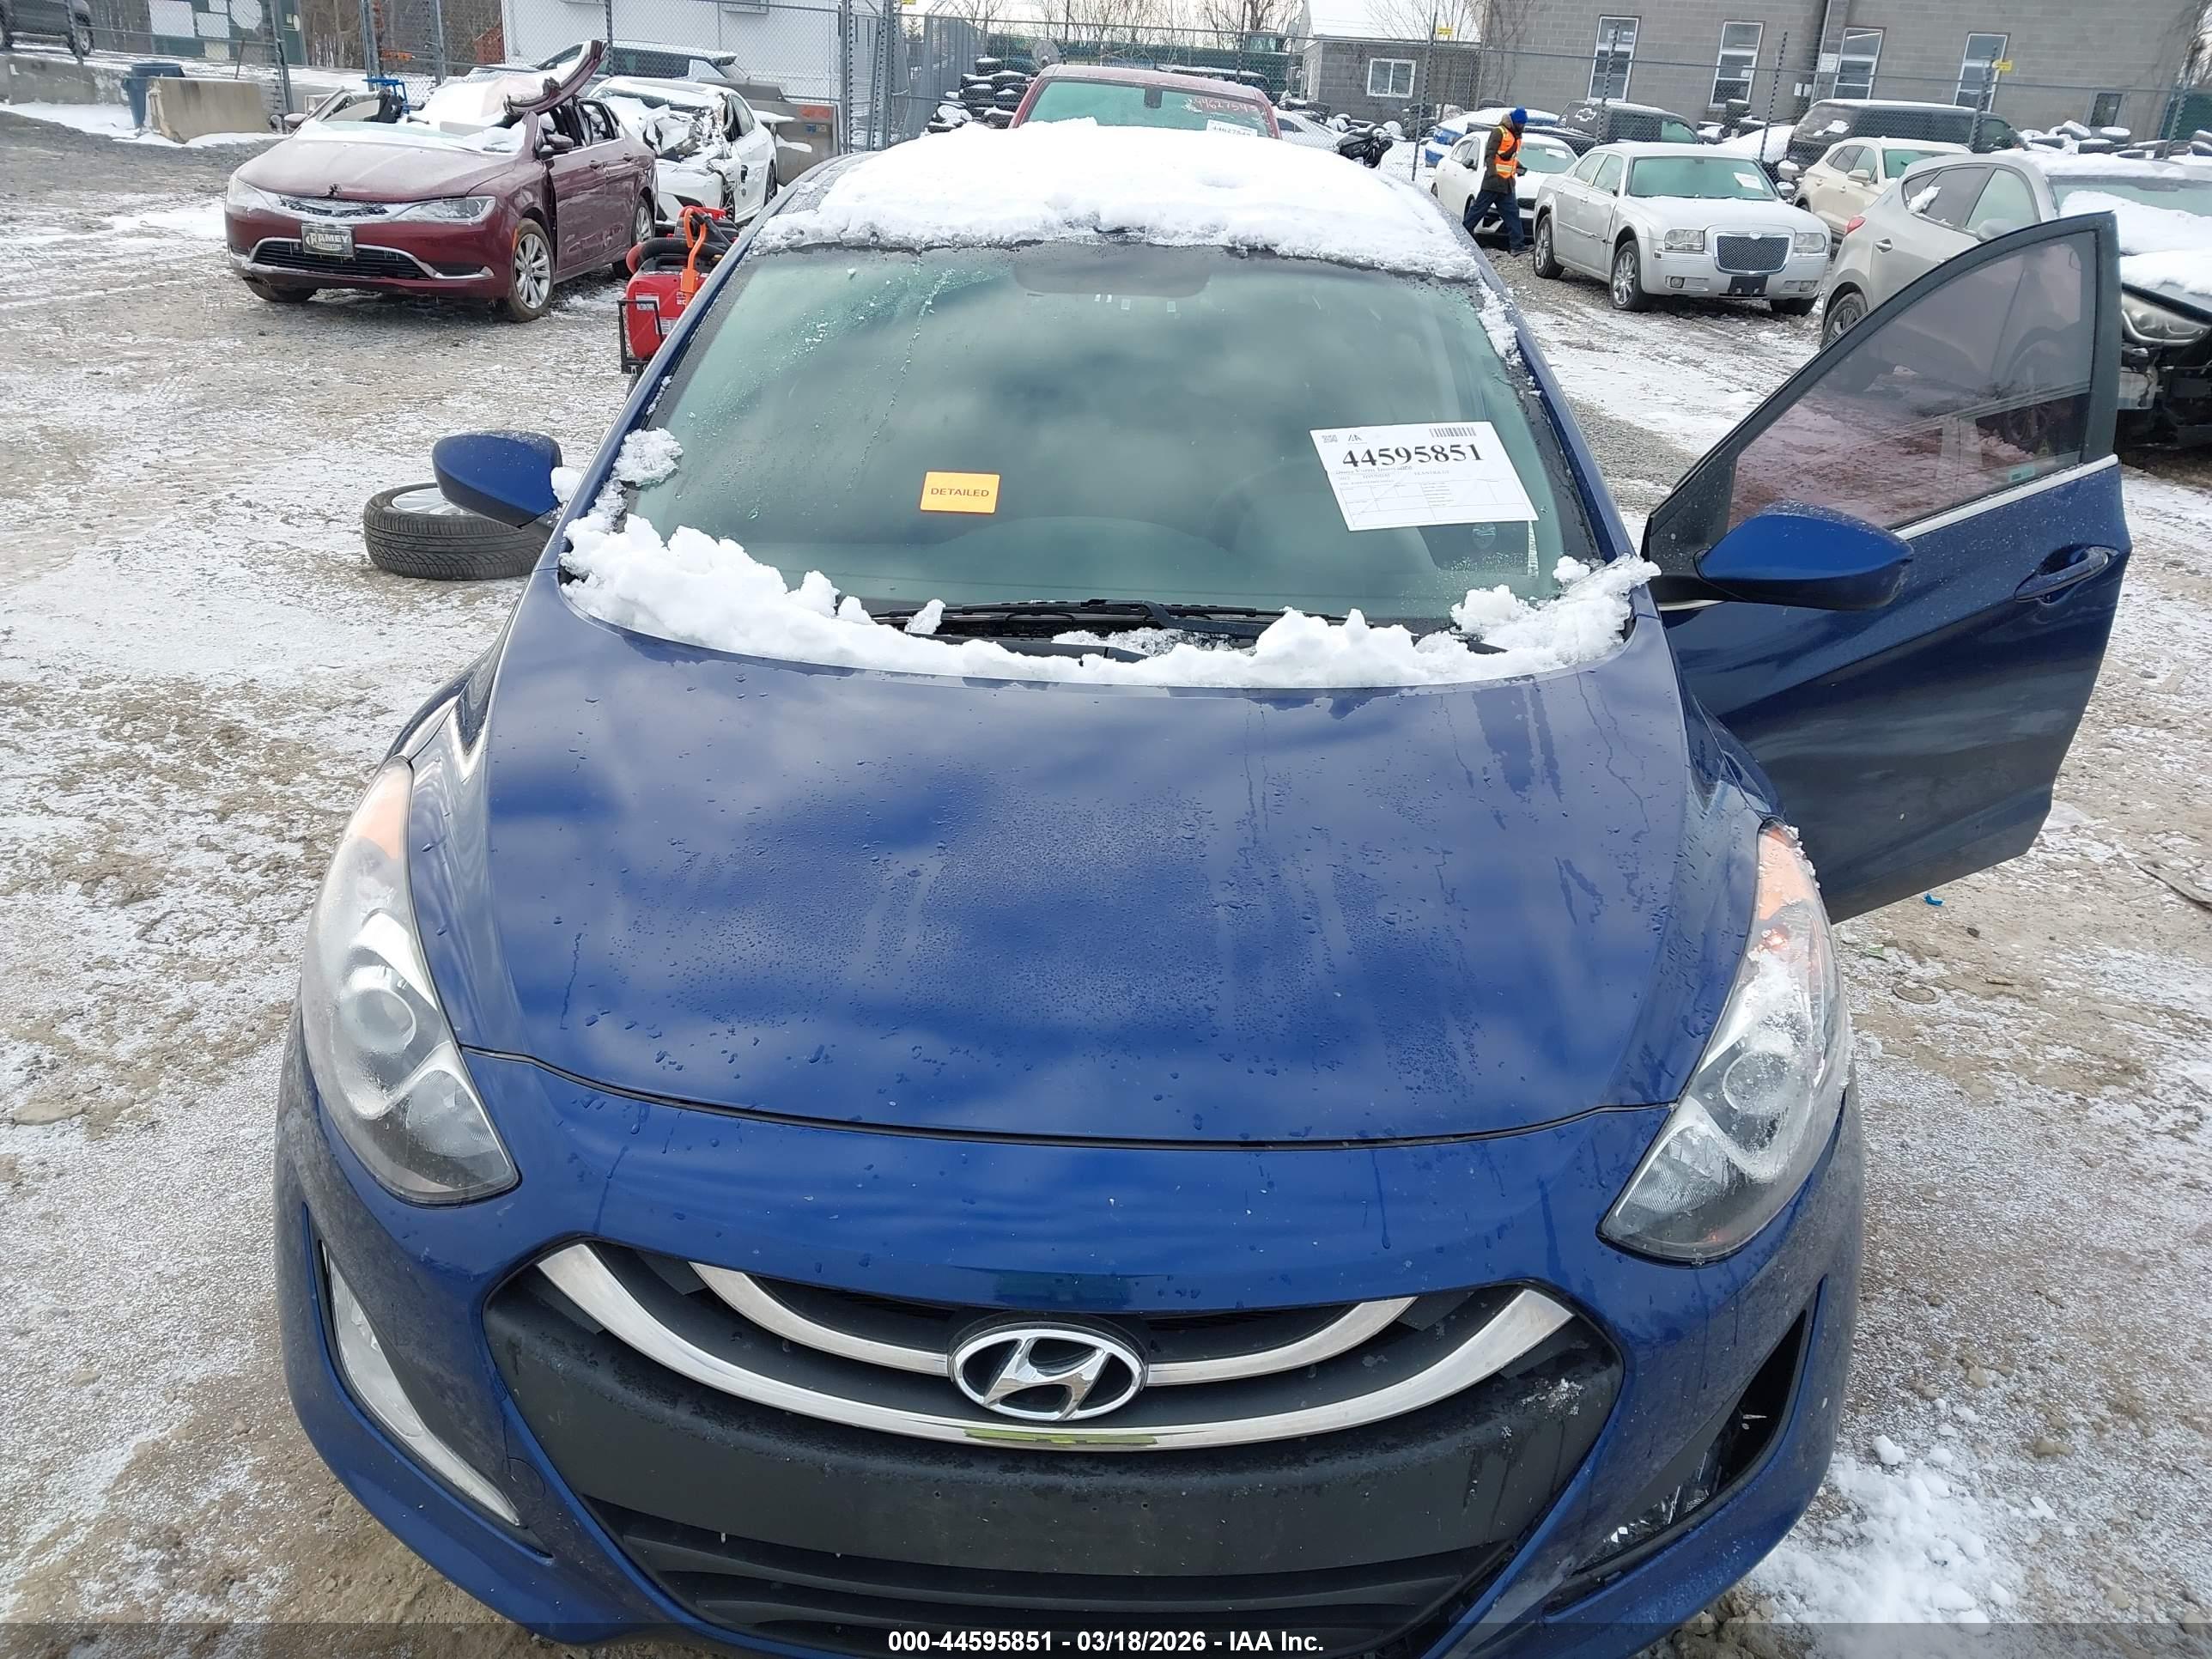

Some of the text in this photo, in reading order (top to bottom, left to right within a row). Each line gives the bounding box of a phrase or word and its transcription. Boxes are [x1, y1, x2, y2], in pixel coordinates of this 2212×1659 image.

[309, 232, 350, 245] RAMEY
[1342, 443, 1484, 467] 44595851
[930, 488, 989, 497] DETAILED
